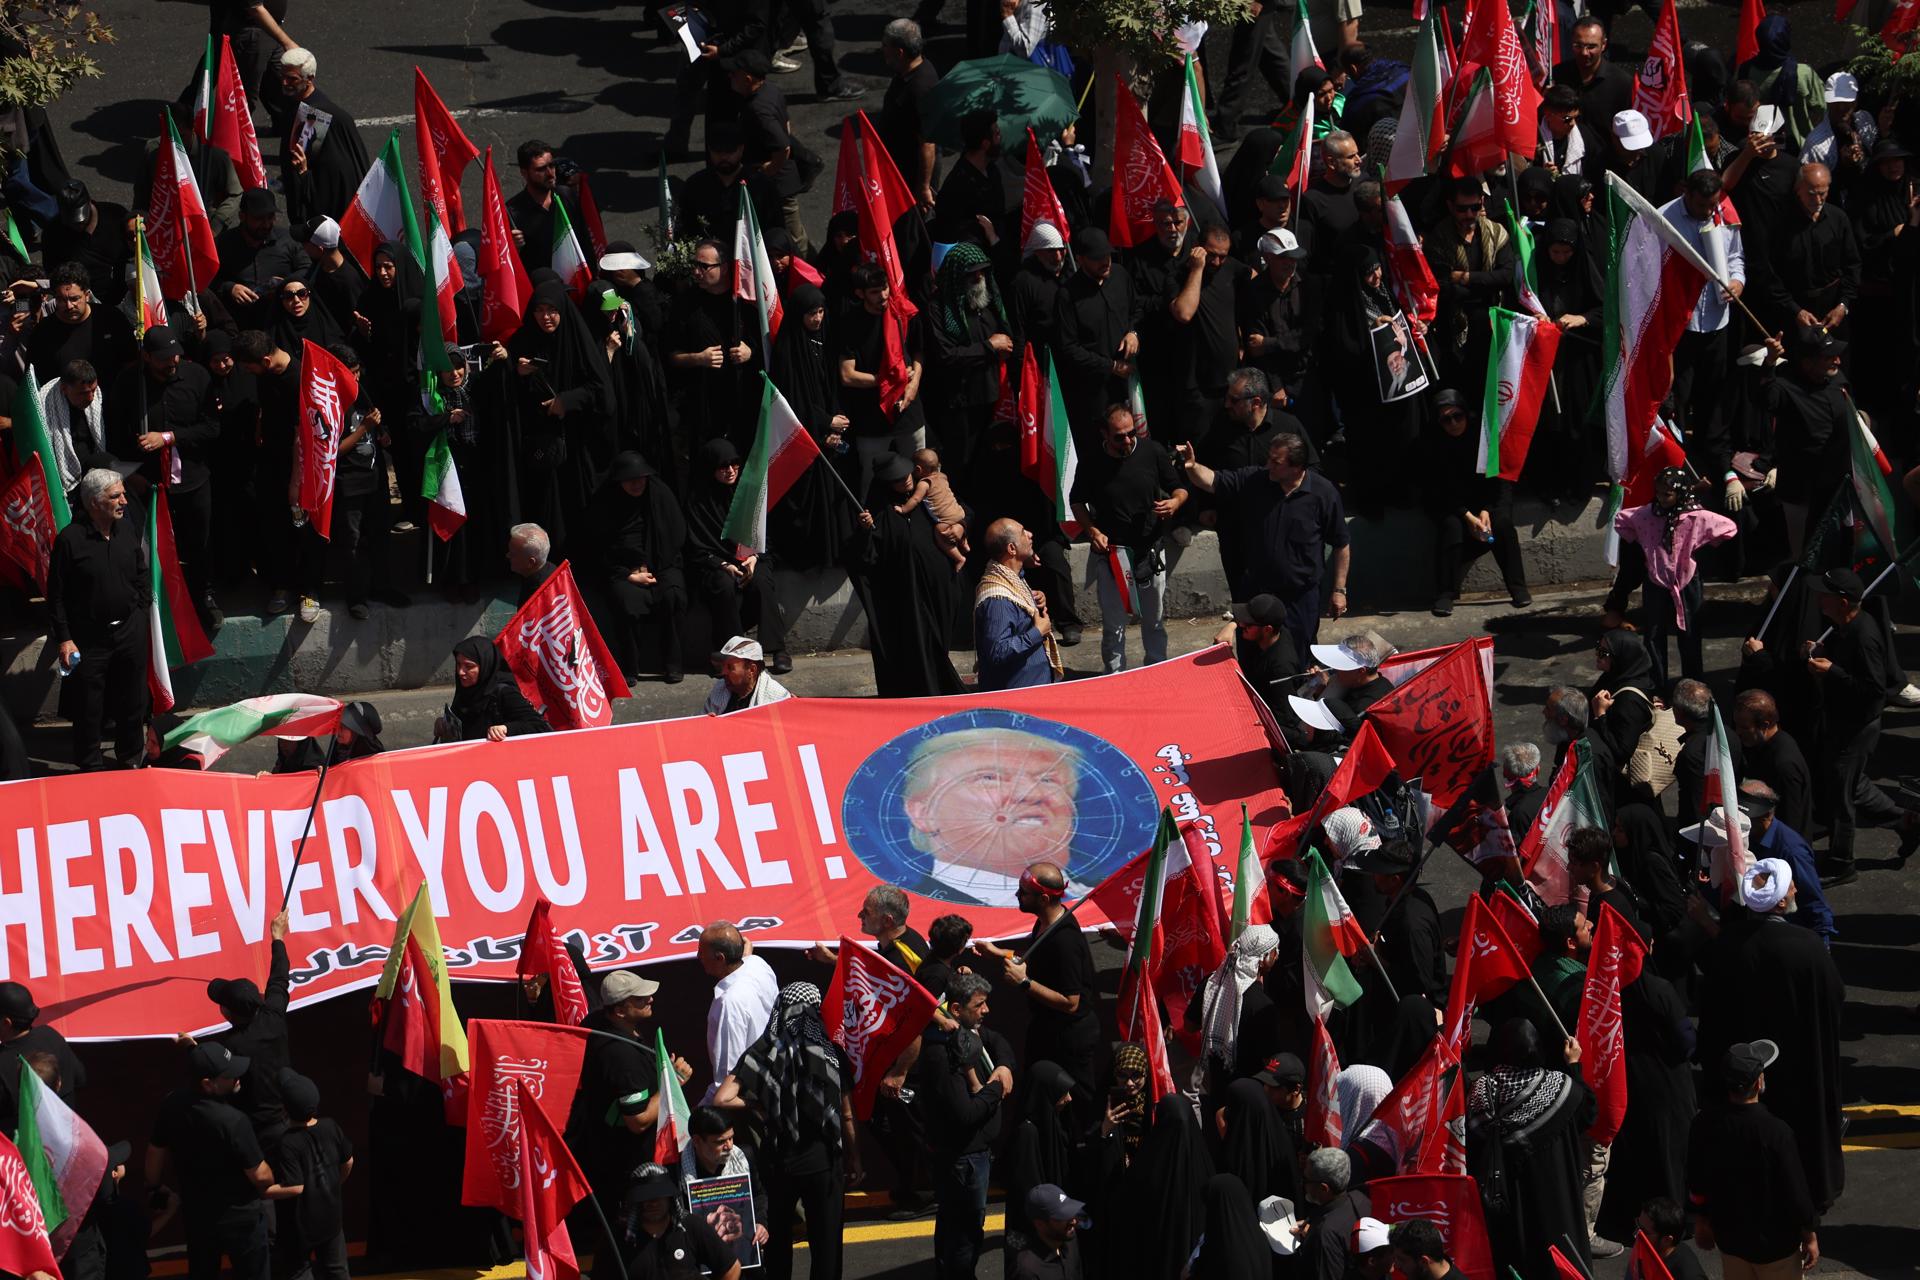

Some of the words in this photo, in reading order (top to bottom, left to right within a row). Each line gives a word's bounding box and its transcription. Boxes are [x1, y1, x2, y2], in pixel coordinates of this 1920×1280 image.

[391, 779, 587, 917] YOU
[619, 751, 792, 900] ARE
[671, 916, 783, 943] هه
